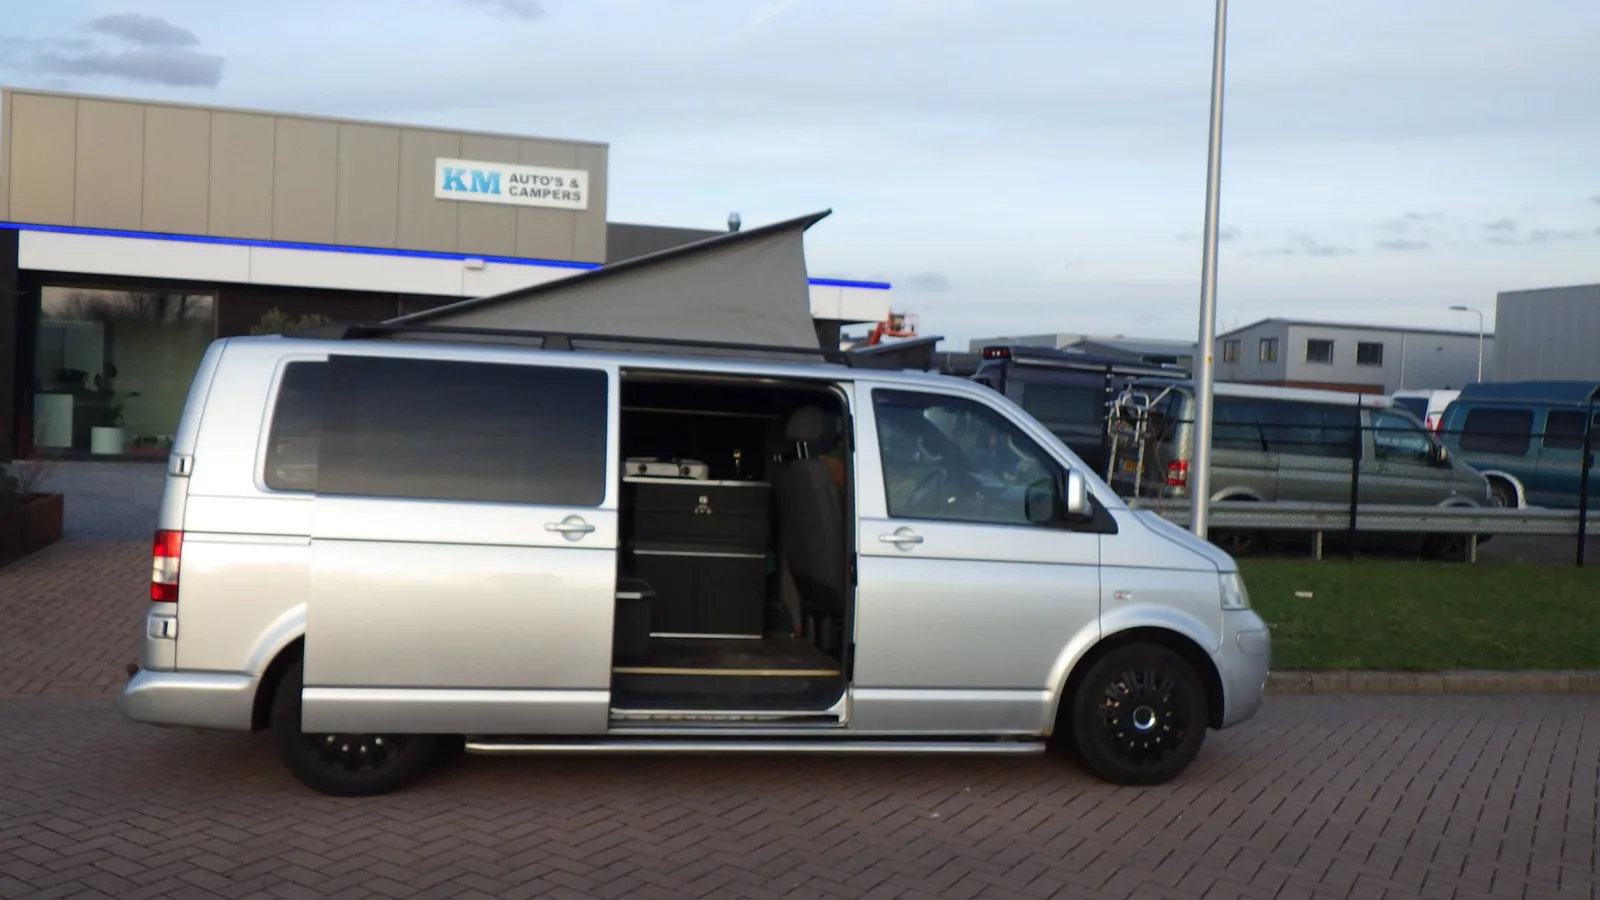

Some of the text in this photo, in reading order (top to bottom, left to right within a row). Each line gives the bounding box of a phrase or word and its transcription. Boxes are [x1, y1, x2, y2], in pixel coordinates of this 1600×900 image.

[442, 166, 502, 195] KM
[509, 173, 580, 188] AUTO'S &
[508, 186, 581, 201] CAMPERS
